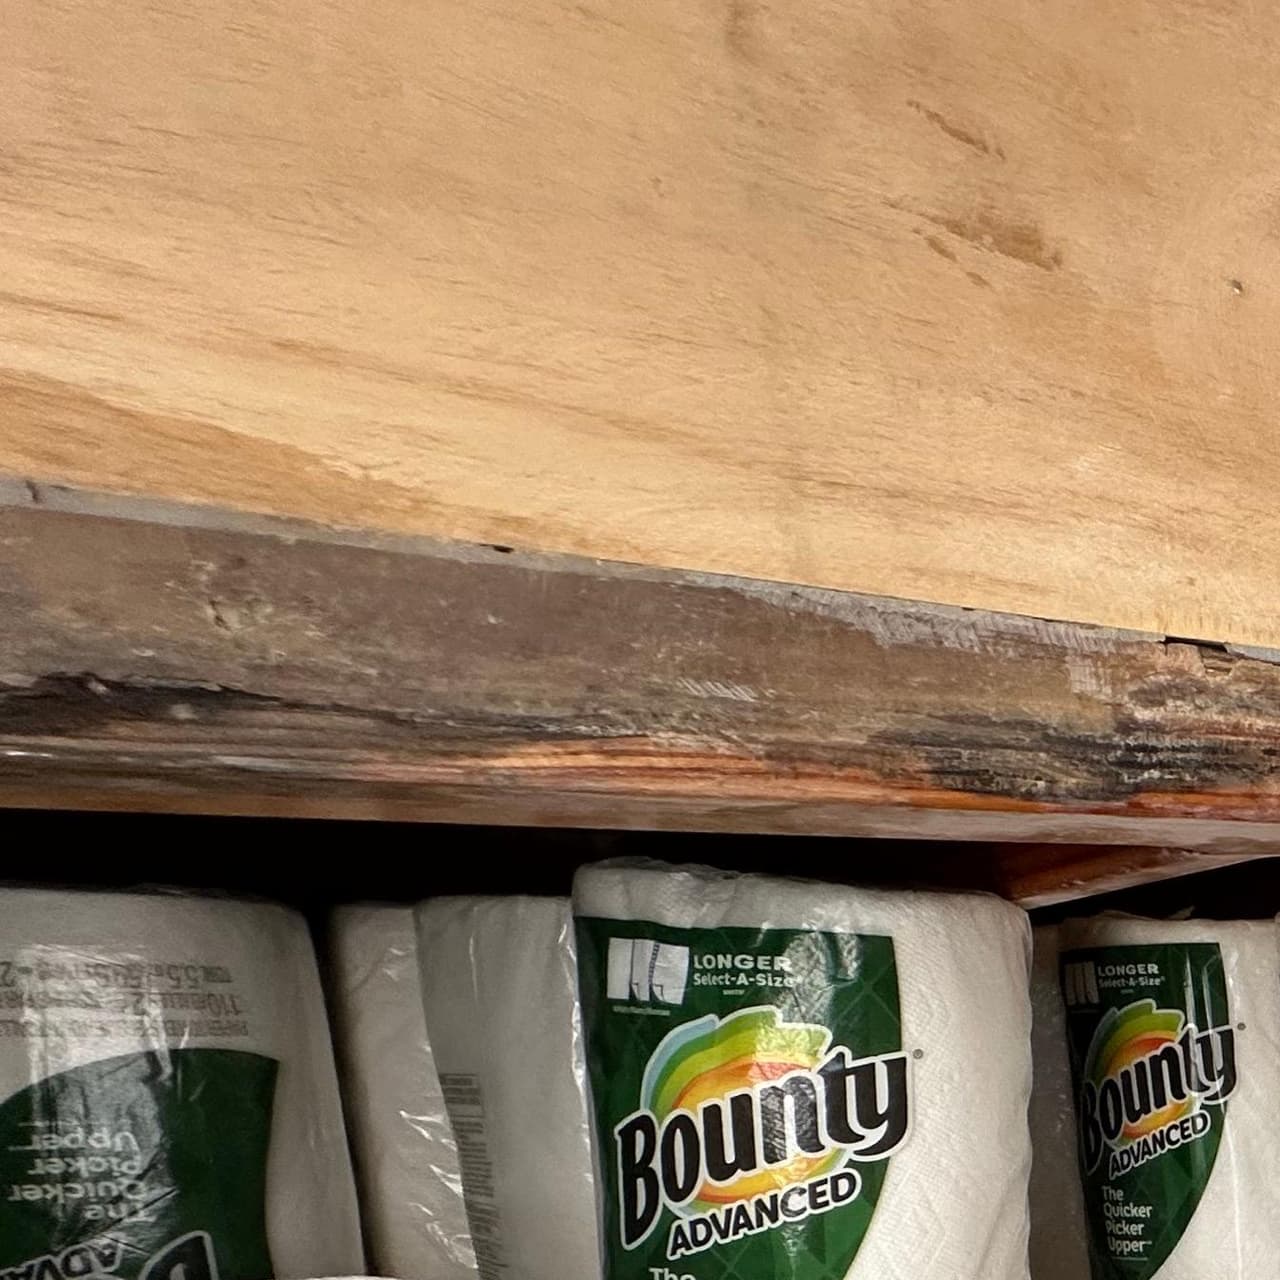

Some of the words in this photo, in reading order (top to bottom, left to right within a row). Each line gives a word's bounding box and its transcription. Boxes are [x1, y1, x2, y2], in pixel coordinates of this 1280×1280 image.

[693, 953, 793, 972] LONGER
[1098, 963, 1159, 977] LONGER
[1081, 1024, 1238, 1174] Bounty
[30, 1126, 140, 1150] Upper
[615, 1047, 913, 1249] Bounty
[1110, 1110, 1211, 1179] ADVANCED
[27, 1156, 143, 1177] Picker
[8, 1177, 147, 1204] Quicker
[1102, 1186, 1123, 1201] The
[669, 1169, 861, 1258] ADVANCED
[1103, 1202, 1153, 1219] Quicker
[1105, 1219, 1144, 1235] Picker
[1107, 1236, 1145, 1255] Upper
